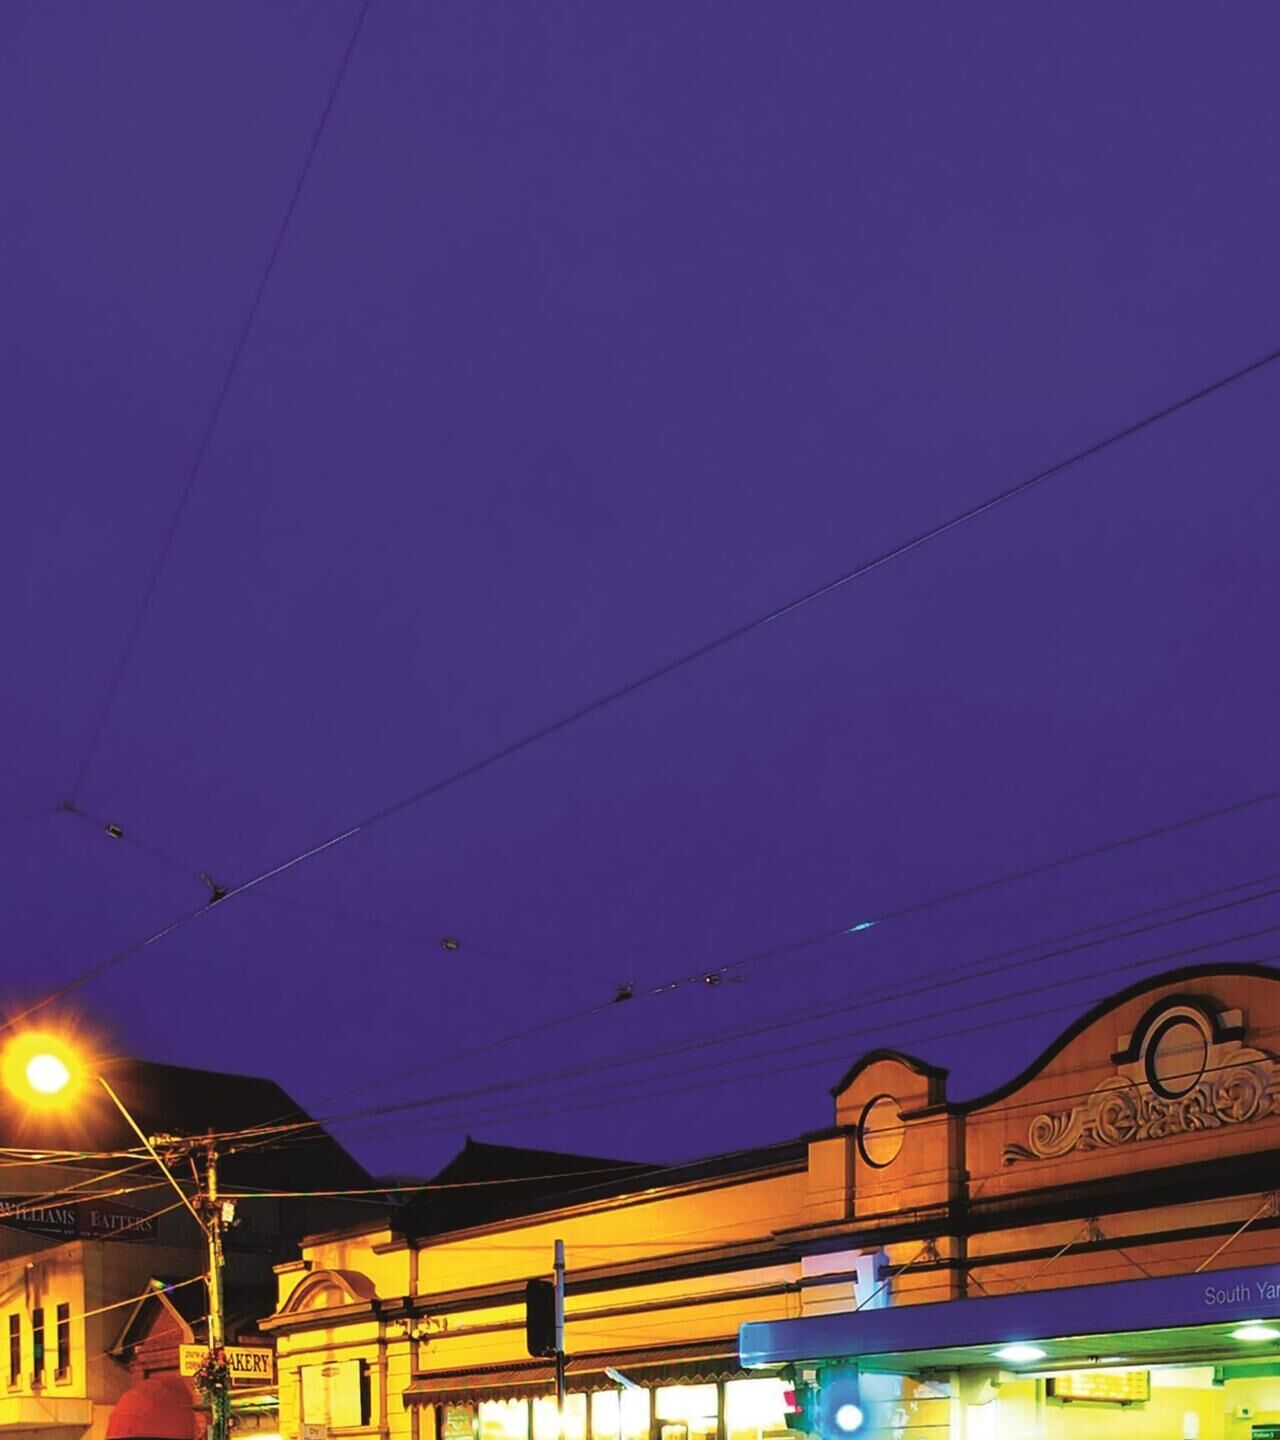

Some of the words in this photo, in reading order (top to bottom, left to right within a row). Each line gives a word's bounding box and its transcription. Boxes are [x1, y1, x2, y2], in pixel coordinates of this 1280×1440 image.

[0, 1201, 76, 1225] WILLIAMS
[1204, 1283, 1251, 1305] South
[228, 1352, 270, 1373] AKERY
